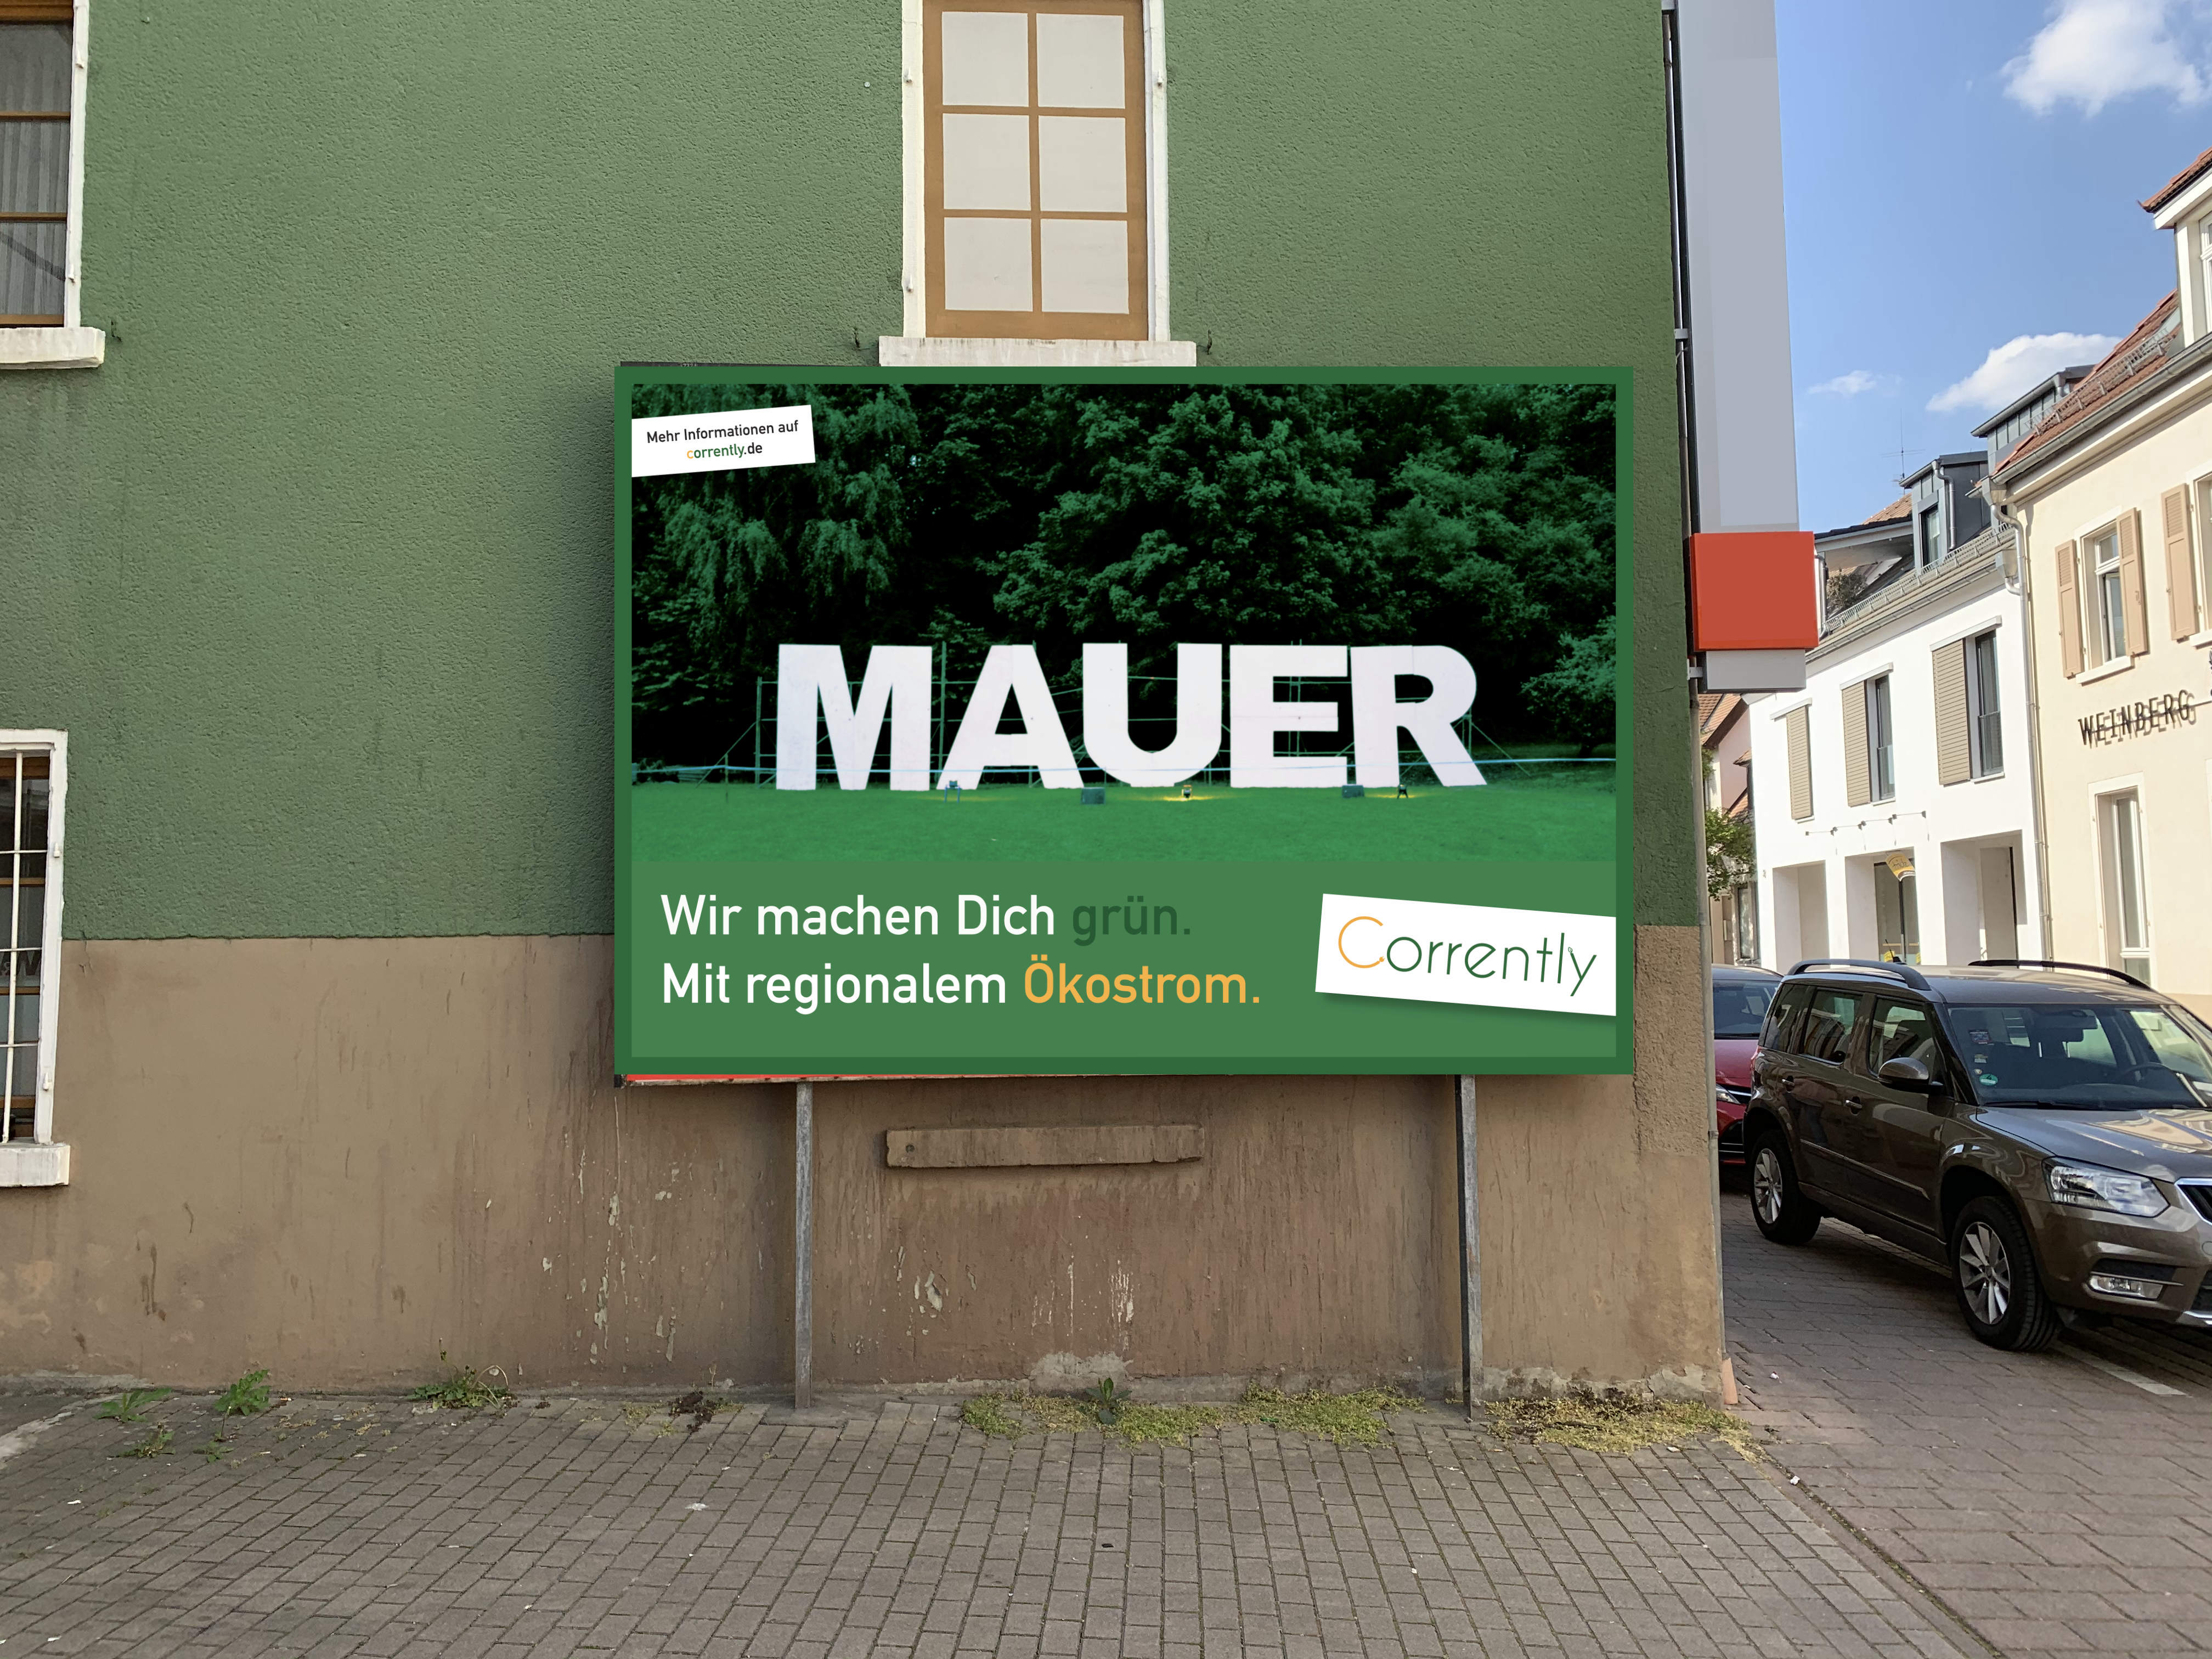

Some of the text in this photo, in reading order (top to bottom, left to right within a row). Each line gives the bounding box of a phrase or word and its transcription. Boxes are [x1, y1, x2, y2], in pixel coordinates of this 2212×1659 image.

[646, 420, 799, 443] Mehr Informationen auf
[686, 442, 763, 459] corrently.de
[776, 643, 1487, 791] MAUER
[2077, 689, 2191, 746] WEINBERG
[661, 894, 1191, 946] Wir machen Dich grün.
[663, 953, 1260, 1015] Mit regionalem Ökostrom.
[1338, 916, 1598, 997] Corrently
